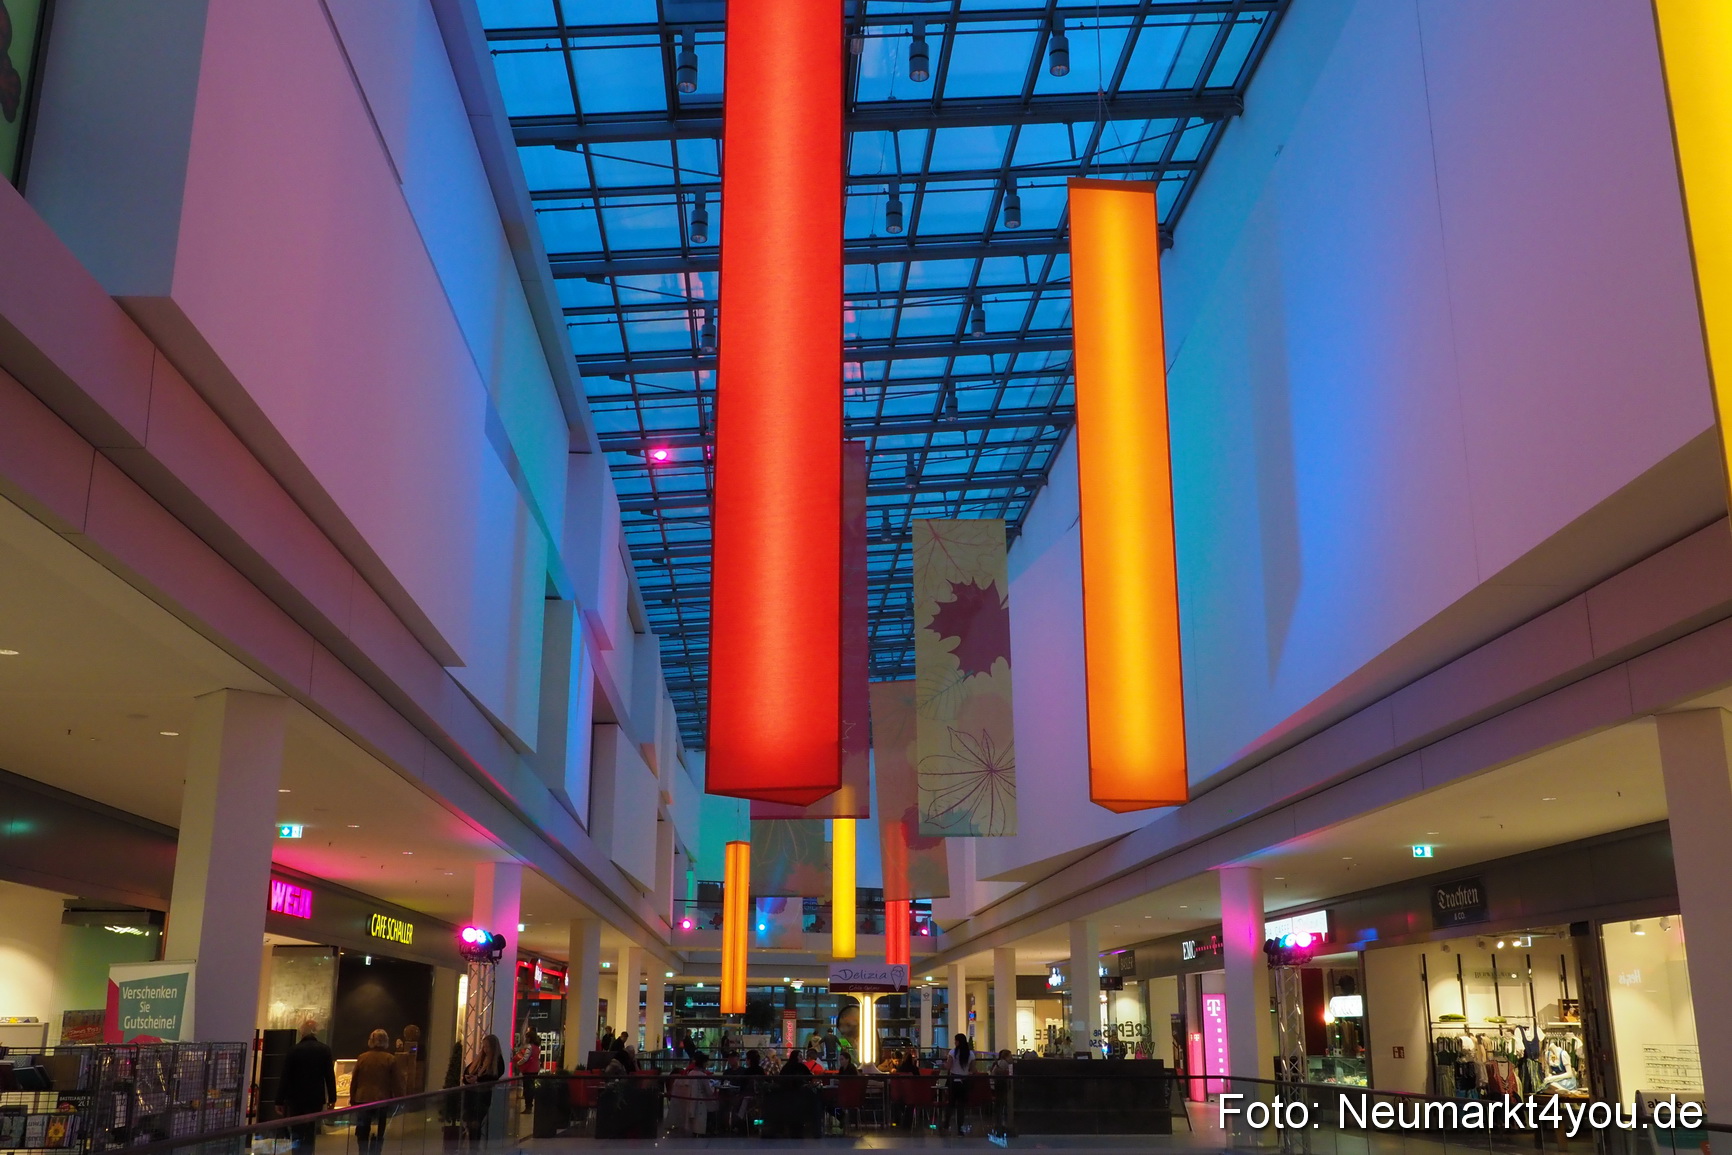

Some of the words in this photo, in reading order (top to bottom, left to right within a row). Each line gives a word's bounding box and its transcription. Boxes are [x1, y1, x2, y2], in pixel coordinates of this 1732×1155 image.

[1437, 885, 1479, 909] Trachten
[386, 917, 414, 945] SCHALLER
[832, 968, 887, 981] Delizia
[122, 985, 178, 999] Verschenken
[139, 1001, 151, 1013] Sie
[1206, 999, 1221, 1017] T
[123, 1015, 177, 1029] Gutscheine!
